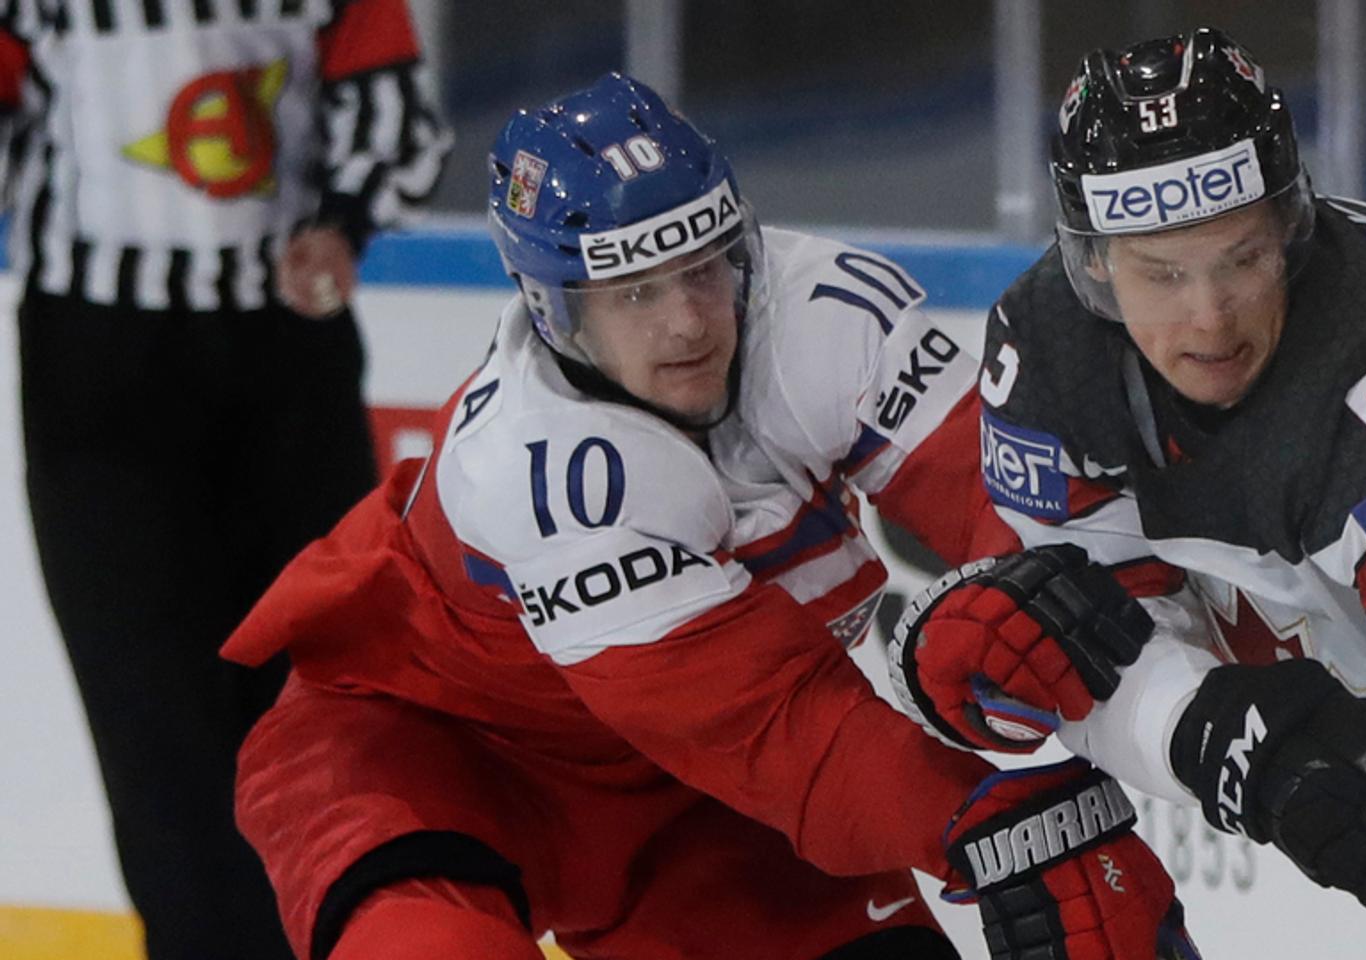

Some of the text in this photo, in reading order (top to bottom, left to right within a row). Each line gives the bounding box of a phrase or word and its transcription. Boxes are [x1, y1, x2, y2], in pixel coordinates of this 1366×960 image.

[1138, 94, 1178, 133] 53
[600, 135, 665, 183] 10
[1091, 157, 1250, 223] zepter
[586, 194, 738, 271] ŠKODA
[808, 252, 923, 336] 10
[524, 436, 625, 538] 10
[520, 545, 713, 627] ŠKODA
[1218, 703, 1268, 838] CCM
